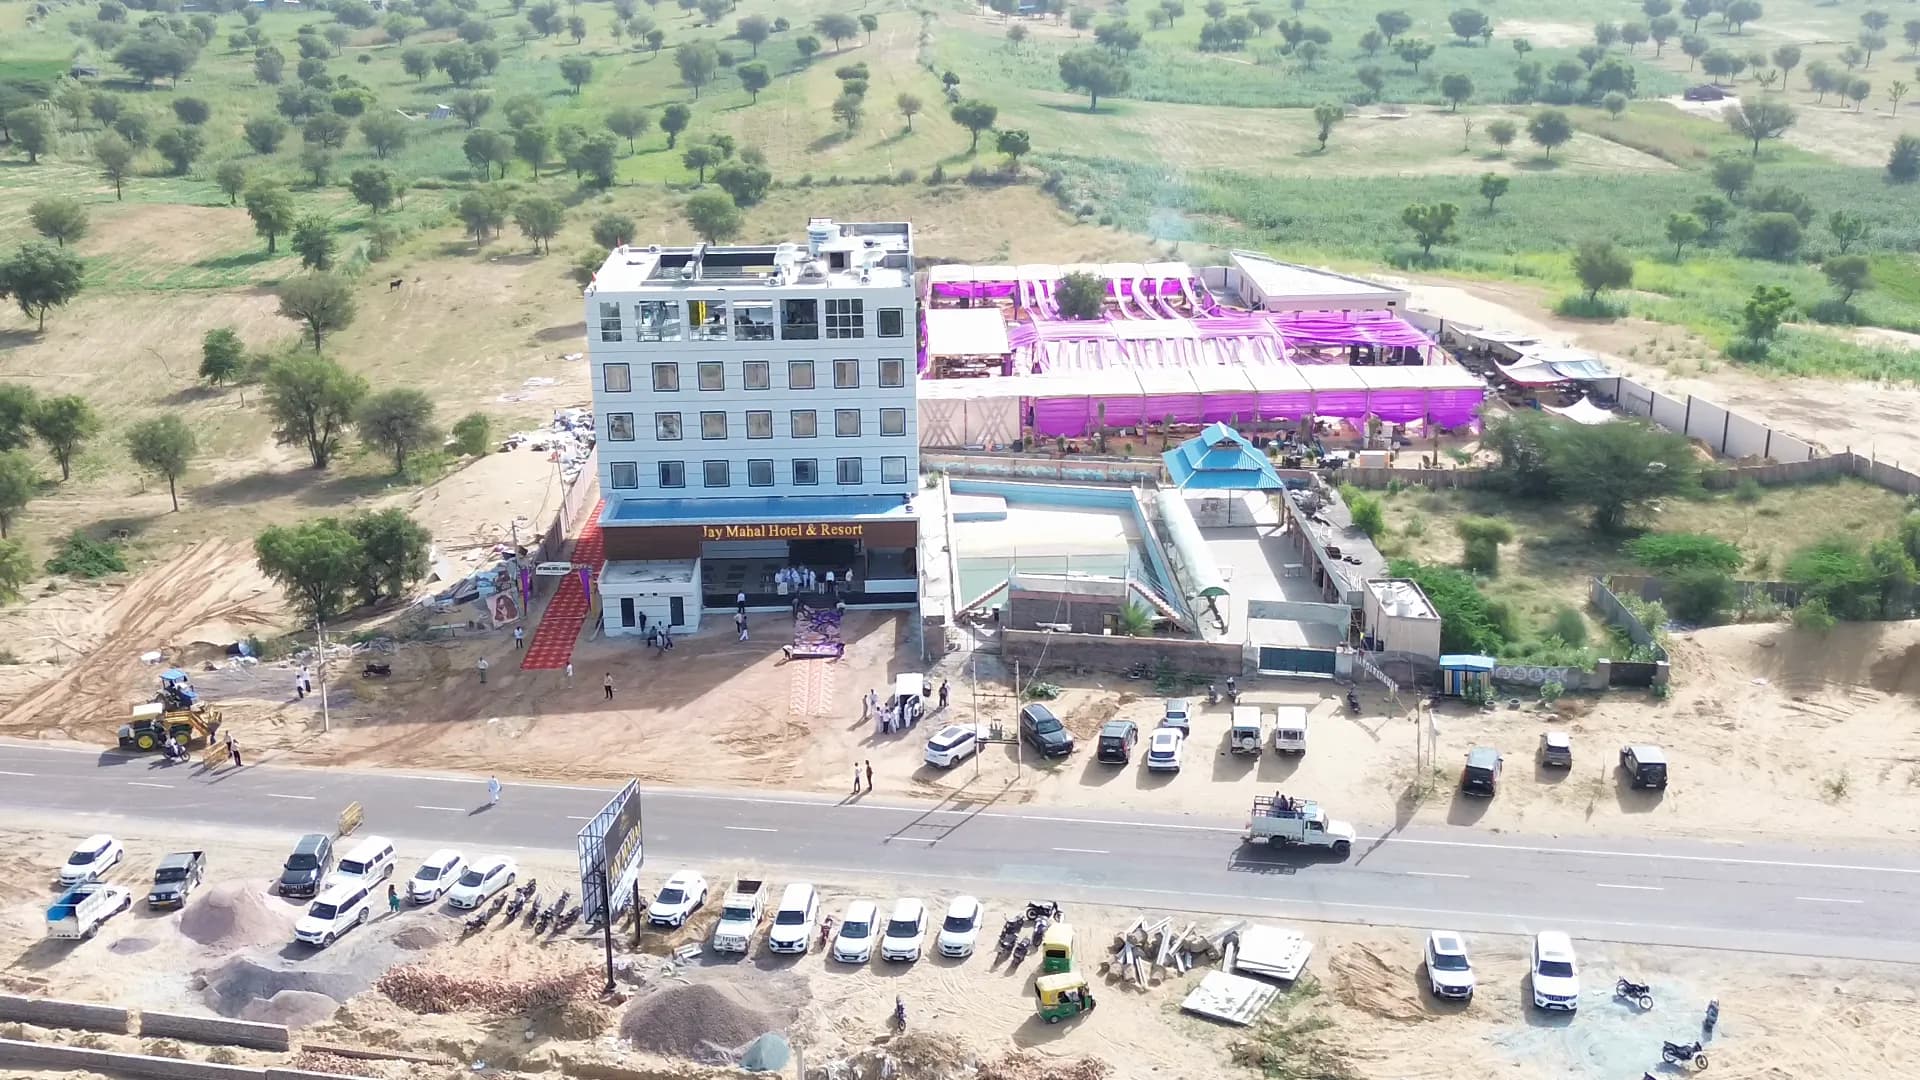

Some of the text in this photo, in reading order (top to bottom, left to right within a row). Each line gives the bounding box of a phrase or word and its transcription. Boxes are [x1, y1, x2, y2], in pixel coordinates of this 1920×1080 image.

[703, 523, 863, 540] Jay Mahal Hotel & Resort
